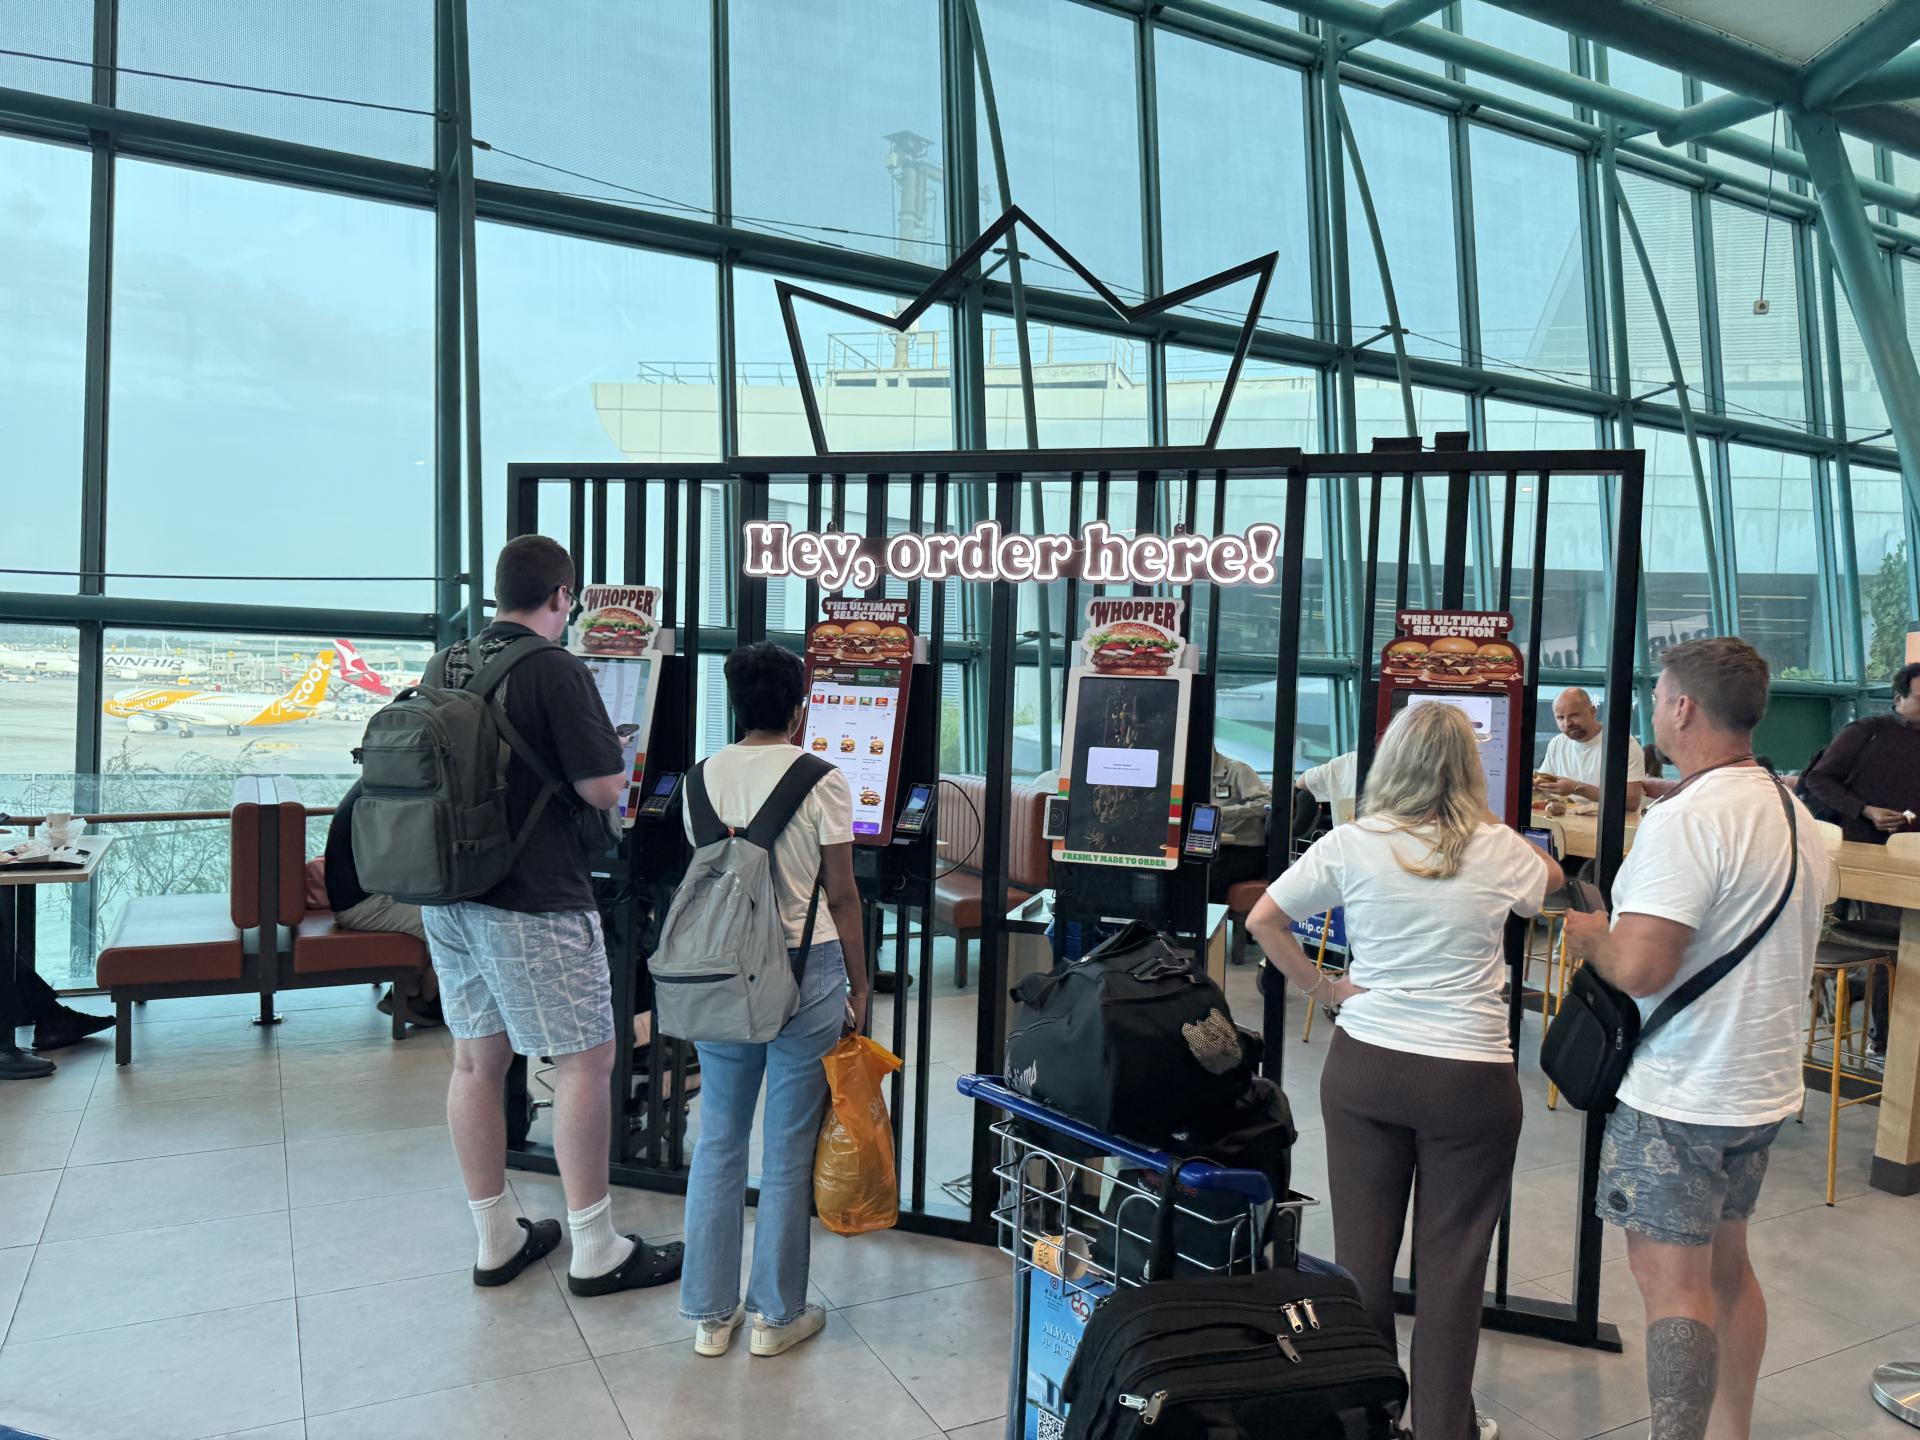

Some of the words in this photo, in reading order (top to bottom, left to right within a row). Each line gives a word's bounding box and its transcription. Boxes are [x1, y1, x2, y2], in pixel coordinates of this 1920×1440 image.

[746, 523, 876, 589] Hey,
[887, 522, 1073, 580] order
[1083, 523, 1279, 584] here!
[585, 588, 654, 616] WHOPPER
[825, 601, 849, 610] THE
[849, 601, 906, 613] ULTIMATE
[833, 610, 895, 622] SELECTION
[1090, 601, 1176, 632] WHOPPER
[1401, 614, 1431, 625] THE
[1433, 615, 1508, 628] ULTIMATE
[1412, 625, 1495, 638] SELECTION
[105, 656, 185, 668] NNAIR
[281, 658, 330, 712] scoot
[1062, 852, 1100, 864] FRESHLY
[1101, 855, 1124, 865] MADE
[1126, 856, 1136, 865] TO
[1138, 857, 1167, 867] ORDER
[1042, 1321, 1080, 1348] ALWAY
